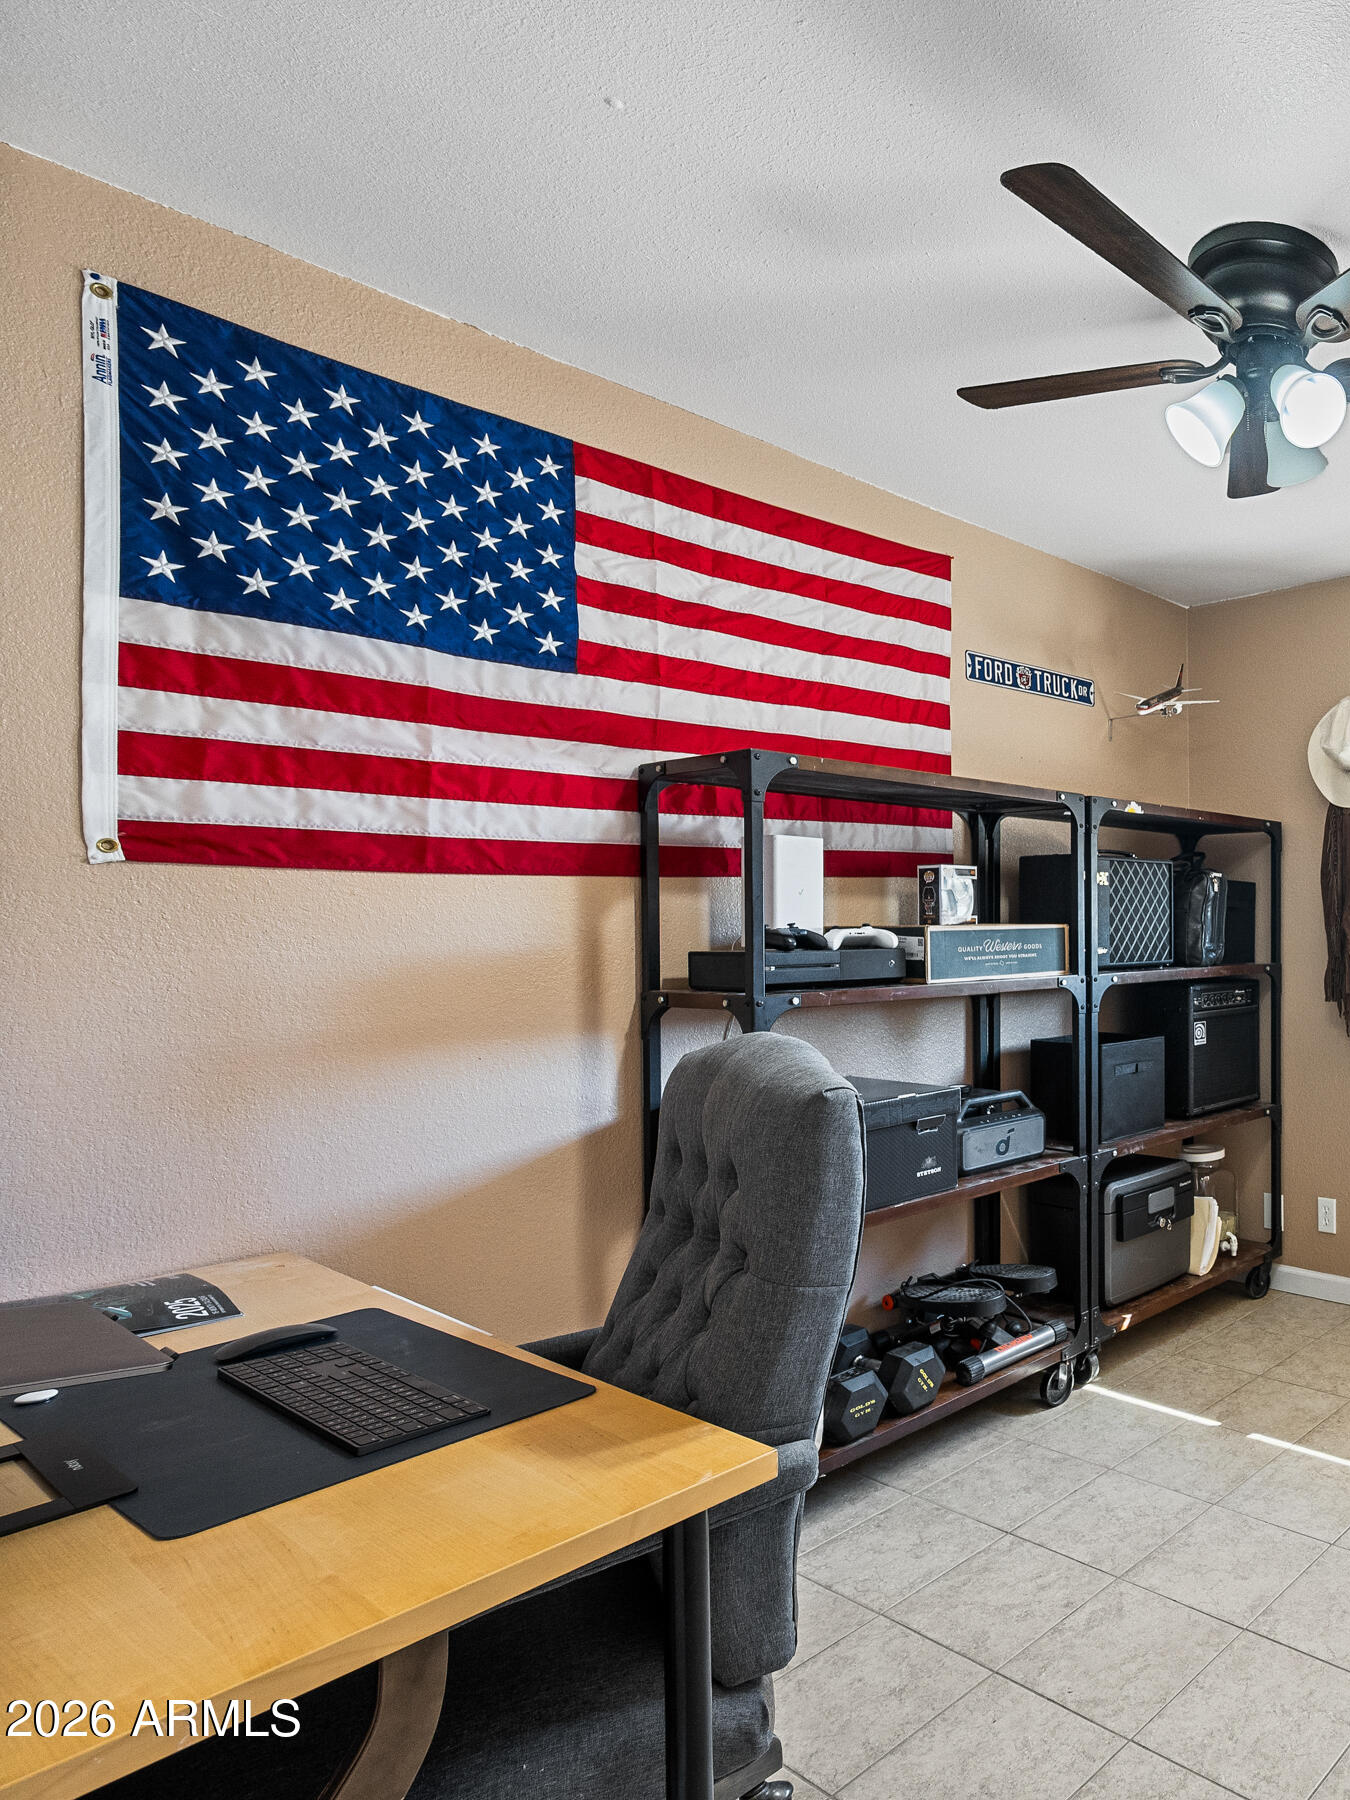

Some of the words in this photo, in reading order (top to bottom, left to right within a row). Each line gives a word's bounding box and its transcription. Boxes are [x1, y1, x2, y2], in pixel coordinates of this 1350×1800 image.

[91, 353, 106, 385] Annin
[974, 656, 1013, 685] FORD
[1034, 670, 1079, 700] TRUCK
[1078, 685, 1088, 697] DR
[957, 945, 983, 953] QUALITY
[982, 939, 1022, 953] Western
[164, 1297, 209, 1320] 2025
